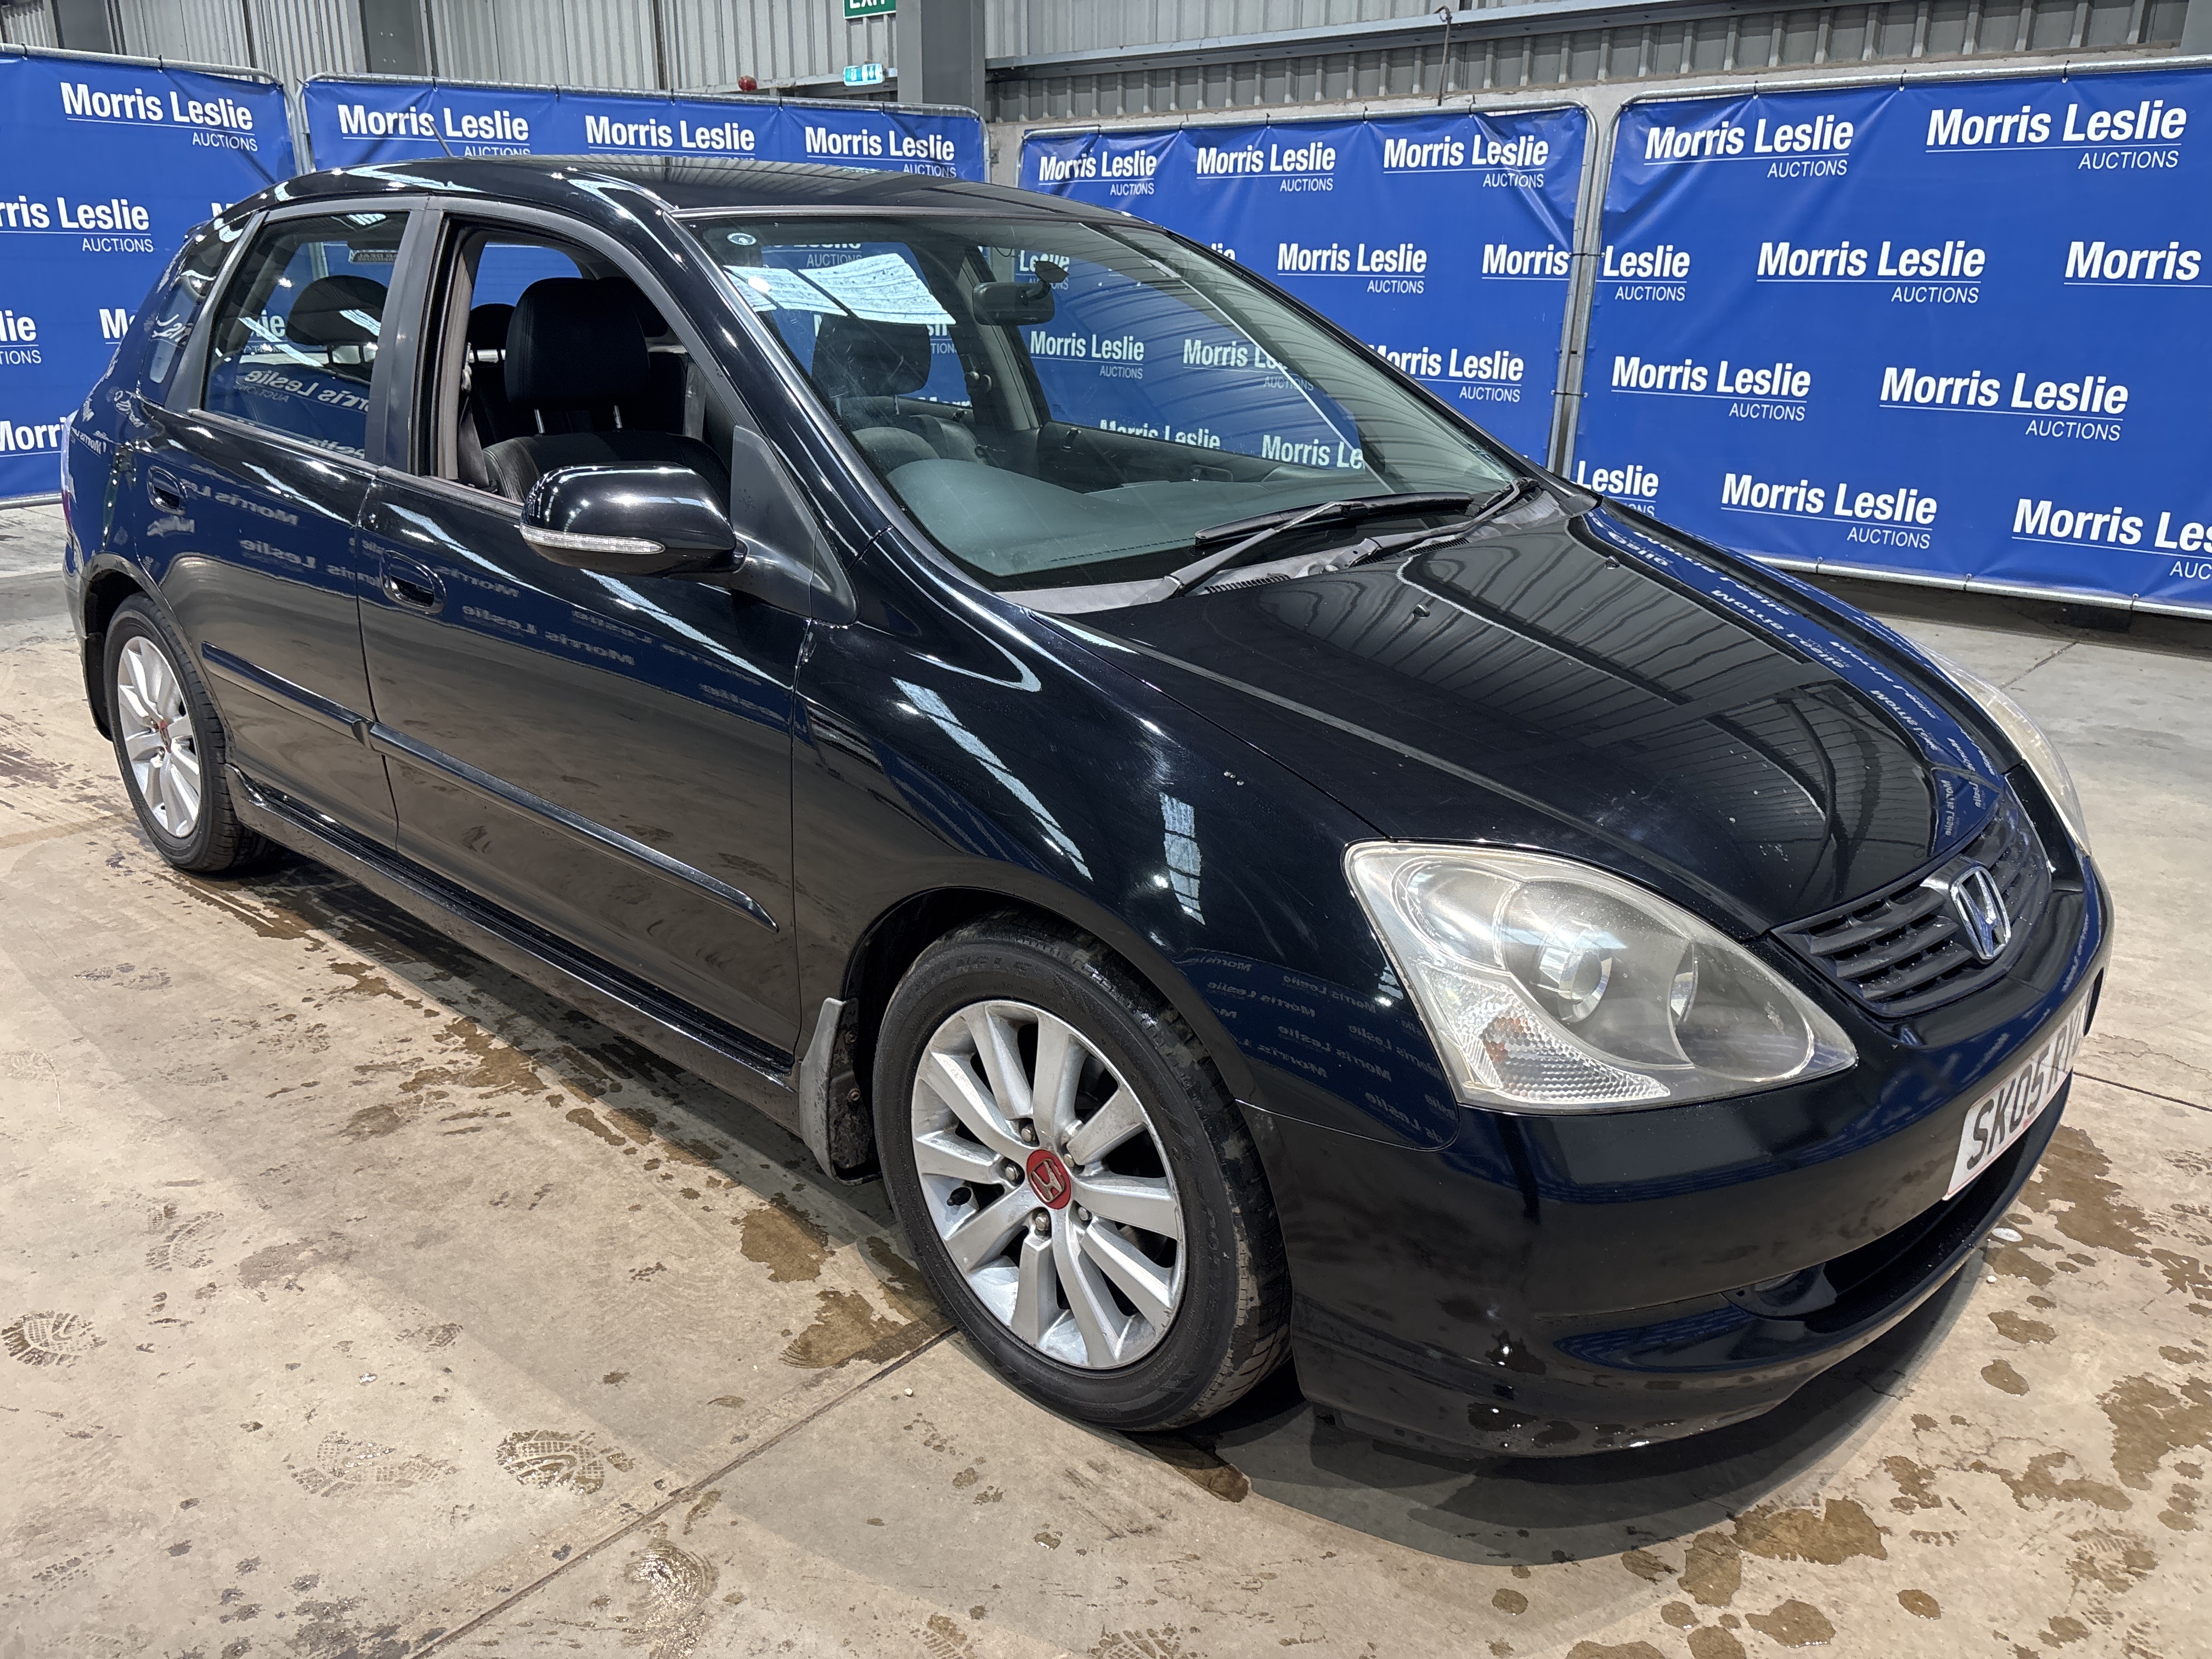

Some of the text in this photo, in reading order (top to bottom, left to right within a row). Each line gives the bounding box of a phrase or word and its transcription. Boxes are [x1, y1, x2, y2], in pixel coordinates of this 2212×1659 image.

[60, 82, 253, 131] Morris Leslie
[1927, 100, 2187, 145] Morris Leslie
[338, 105, 529, 141] Morris Leslie
[585, 115, 755, 151] Morris Leslie
[1645, 115, 1854, 159] Morris Leslie
[192, 132, 258, 152] AUCTIONS
[805, 126, 955, 161] Morris Leslie
[1197, 142, 1336, 174] Morris Leslie
[1384, 134, 1549, 168] Morris Leslie
[903, 163, 957, 178] AUCTIONS
[1039, 150, 1157, 182] Morris Leslie
[1767, 160, 1848, 178] AUCTIONS
[2078, 151, 2179, 170] AUCTIONS
[1110, 183, 1154, 196] AUCTIONS
[1280, 178, 1333, 192] AUCTIONS
[1483, 172, 1544, 188] AUCTIONS
[0, 195, 149, 230] rris Leslie
[82, 238, 154, 252] AUCTIONS
[1277, 242, 1427, 273] Morris Leslie
[1482, 244, 1690, 278] Morris Leslie
[1758, 240, 1985, 277] Morris Leslie
[2065, 241, 2202, 281] Morris
[1367, 280, 1424, 294] AUCTIONS
[1615, 286, 1686, 301] AUCTIONS
[1891, 287, 1979, 303] AUCTIONS
[0, 310, 37, 341] lie
[0, 349, 42, 365] TIONS
[1030, 330, 1145, 362] Morris Leslie
[1183, 338, 1248, 368] Morris
[1099, 364, 1144, 380] AUCTIONS
[1448, 348, 1523, 382] Leslie
[1611, 356, 1811, 397] Morris Leslie
[1459, 387, 1521, 403] AUCTIONS
[1880, 367, 2129, 414] Morris Leslie
[1729, 403, 1805, 421] AUCTIONS
[2025, 420, 2121, 441] AUCTIONS
[1262, 434, 1330, 467] Morris
[1577, 460, 1659, 498] Leslie
[1722, 473, 1937, 525] Morris Leslie
[1847, 527, 1931, 549] AUCTIONS
[2012, 498, 2212, 553] Morris Les
[1967, 1043, 2051, 1170] SK05
